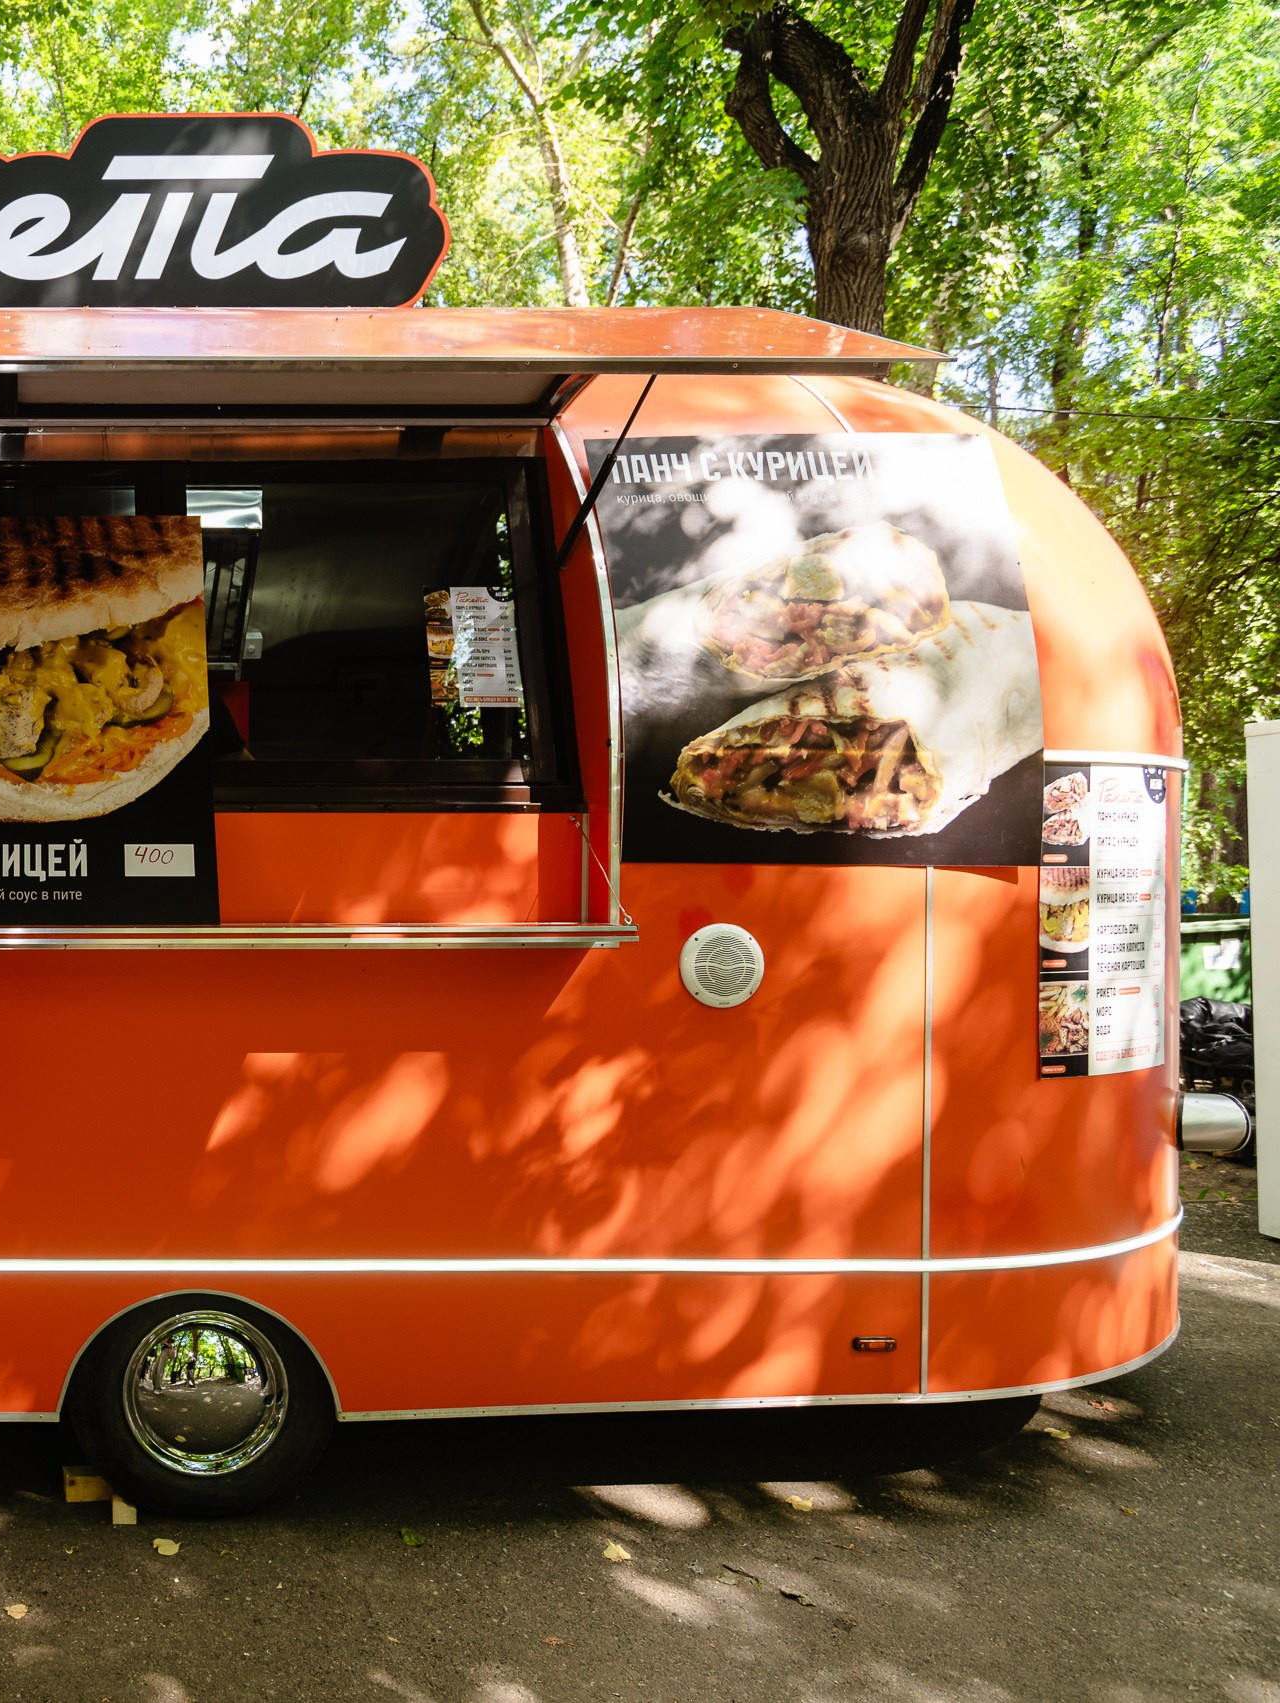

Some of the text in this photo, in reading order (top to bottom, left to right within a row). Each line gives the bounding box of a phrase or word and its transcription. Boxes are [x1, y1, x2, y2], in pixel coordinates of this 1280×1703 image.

[612, 447, 878, 485] ПАНЧ С КУРИЦЕЙ
[617, 493, 666, 505] курица,
[134, 845, 175, 866] 400
[9, 890, 38, 903] соус
[41, 890, 49, 901] в
[53, 890, 83, 901] пите
